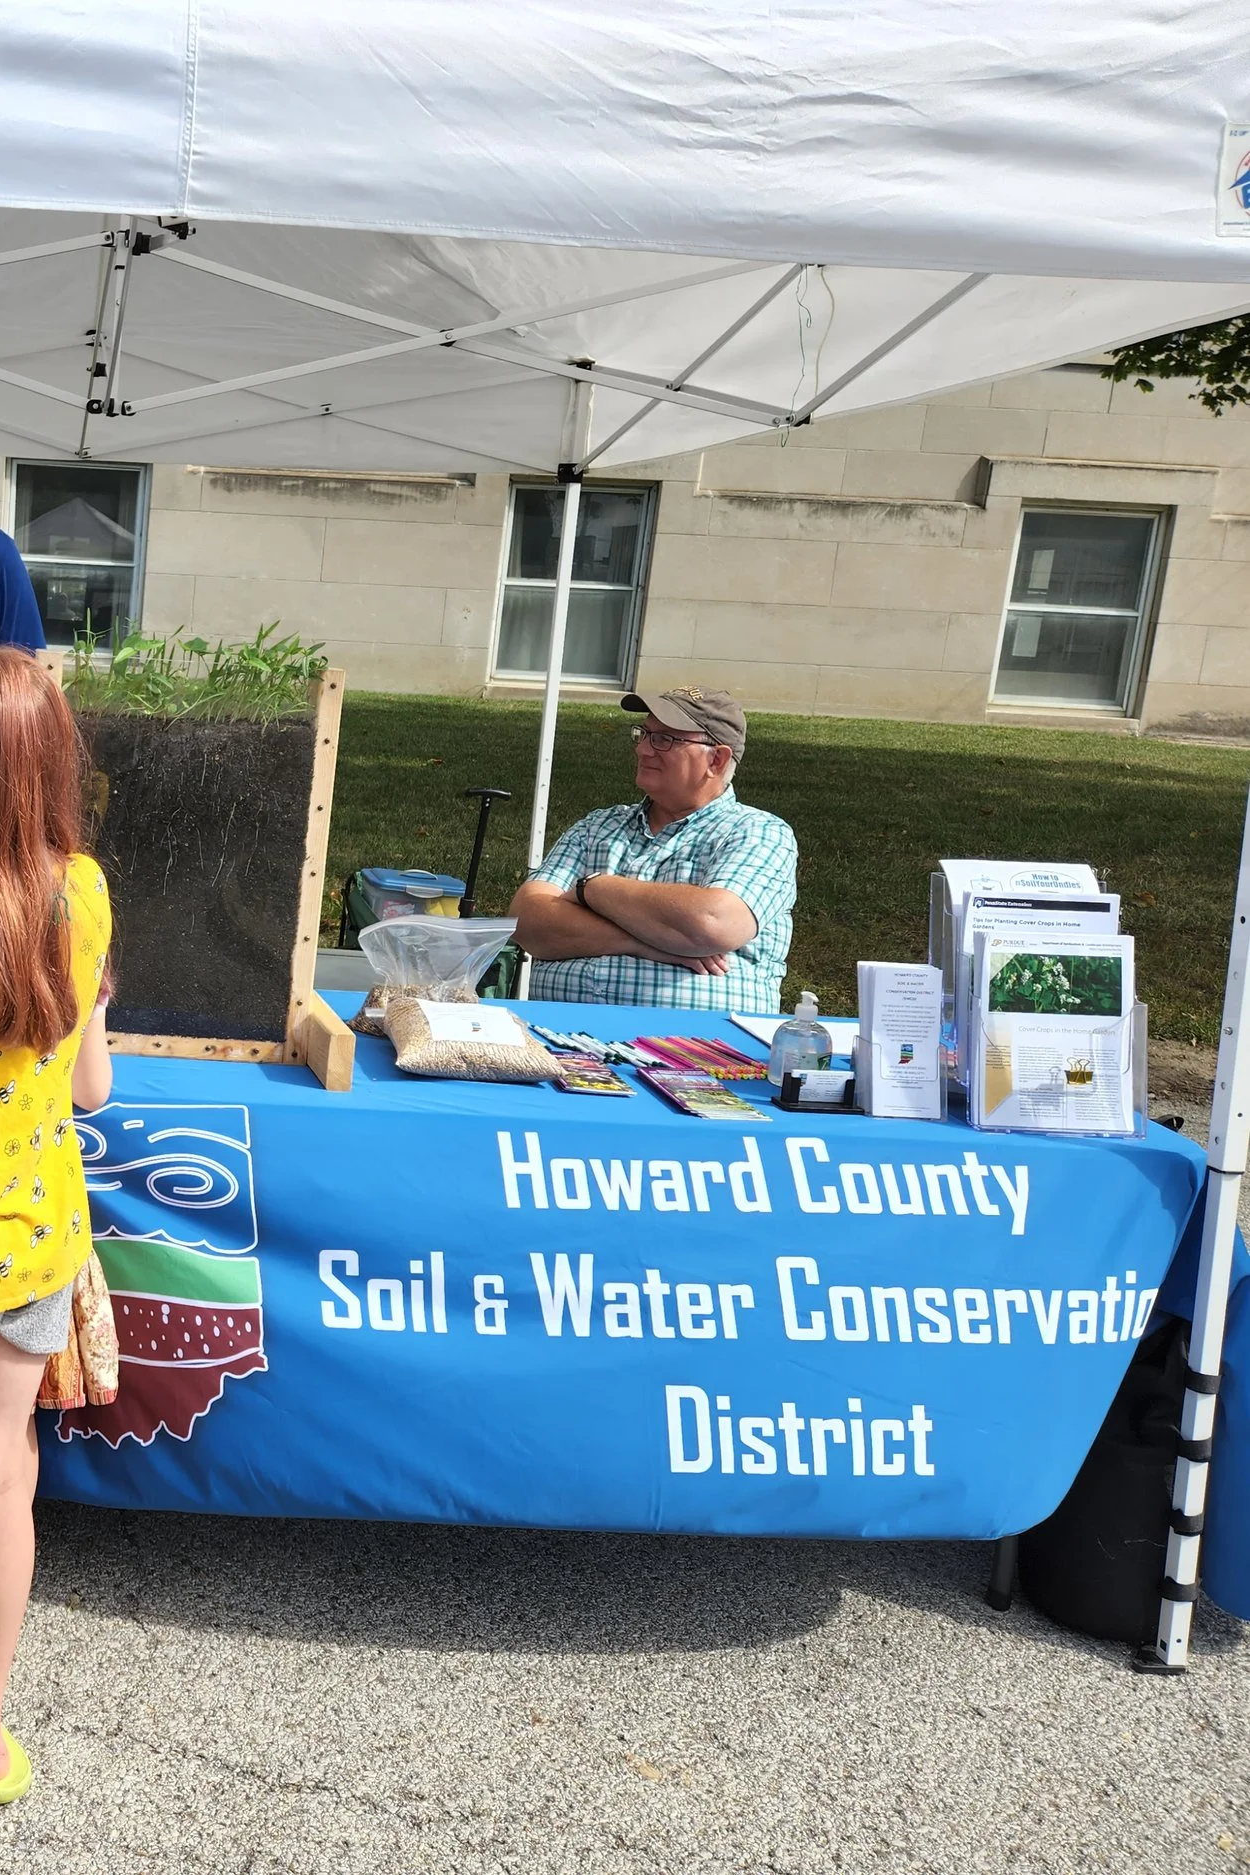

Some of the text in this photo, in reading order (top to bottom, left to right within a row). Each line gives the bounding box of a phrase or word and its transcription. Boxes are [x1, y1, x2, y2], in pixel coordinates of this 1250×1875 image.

[1031, 873, 1050, 881] How
[497, 1131, 1030, 1235] Howard County
[318, 1249, 1159, 1345] Soil & Water Conservatio
[665, 1384, 935, 1476] District
